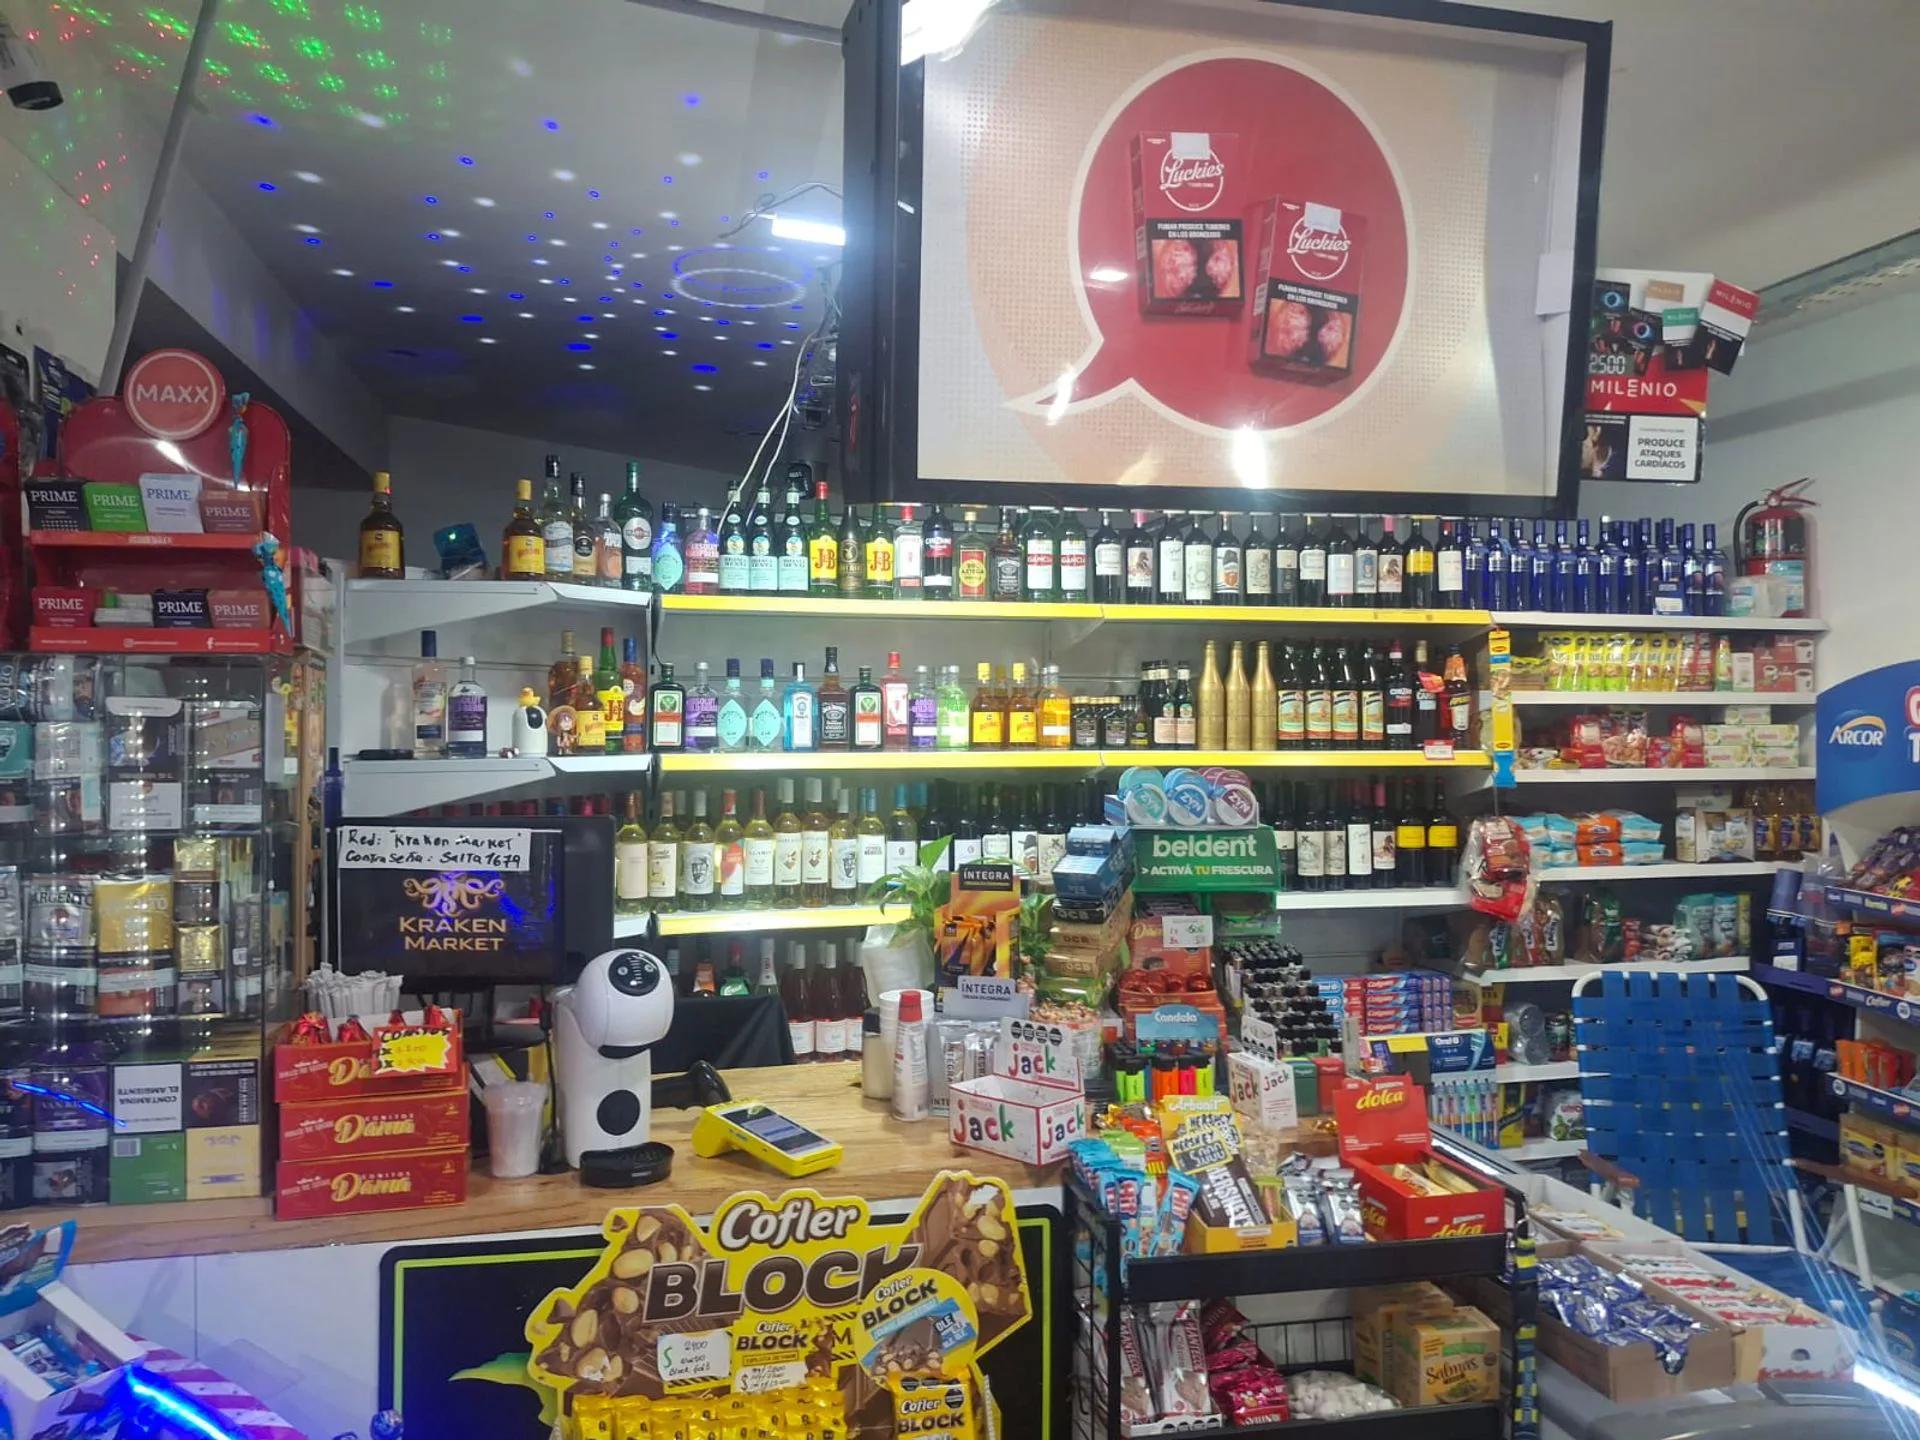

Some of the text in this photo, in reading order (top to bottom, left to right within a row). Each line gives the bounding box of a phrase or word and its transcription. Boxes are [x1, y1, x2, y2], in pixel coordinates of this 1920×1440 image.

[1160, 157, 1224, 190] Luckies
[1286, 227, 1351, 254] Luckies
[1716, 289, 1753, 310] MILENIO
[1589, 354, 1626, 375] 2500
[135, 383, 209, 403] MAXX
[1591, 379, 1678, 398] MILENIO
[1637, 437, 1686, 448] PRODUCE
[1640, 448, 1681, 460] ATAQUES
[31, 490, 78, 503] PRIME
[92, 494, 139, 507] PRIME
[146, 488, 192, 501] PRIME
[205, 506, 251, 518] PRIME
[38, 597, 84, 610] PRIME
[158, 601, 203, 614] PRIME
[214, 604, 259, 616] PRIME
[1828, 725, 1884, 746] ARCOR
[1180, 792, 1205, 813] ZYN
[1227, 791, 1250, 814] ZYN
[1153, 834, 1257, 857] beldent
[1195, 866, 1209, 875] TU
[1212, 866, 1273, 875] FRESCURA
[400, 917, 506, 933] KRAKEN
[404, 937, 504, 951] MARKET
[1008, 1043, 1056, 1077] jack
[1263, 1069, 1290, 1092] jack
[1356, 1089, 1405, 1110] dolca
[954, 1099, 1016, 1143] jack
[1041, 1101, 1085, 1149] jack
[718, 1199, 860, 1251] Cofler
[642, 1243, 924, 1323] BLOCK
[874, 1275, 913, 1302] Cofler
[862, 1278, 939, 1331] BLOCK
[756, 1321, 793, 1334] Cofler
[736, 1335, 809, 1351] BLOCK
[1425, 1358, 1480, 1385] Salmas
[901, 1398, 941, 1414] Cofler
[898, 1413, 965, 1433] BLOCK
